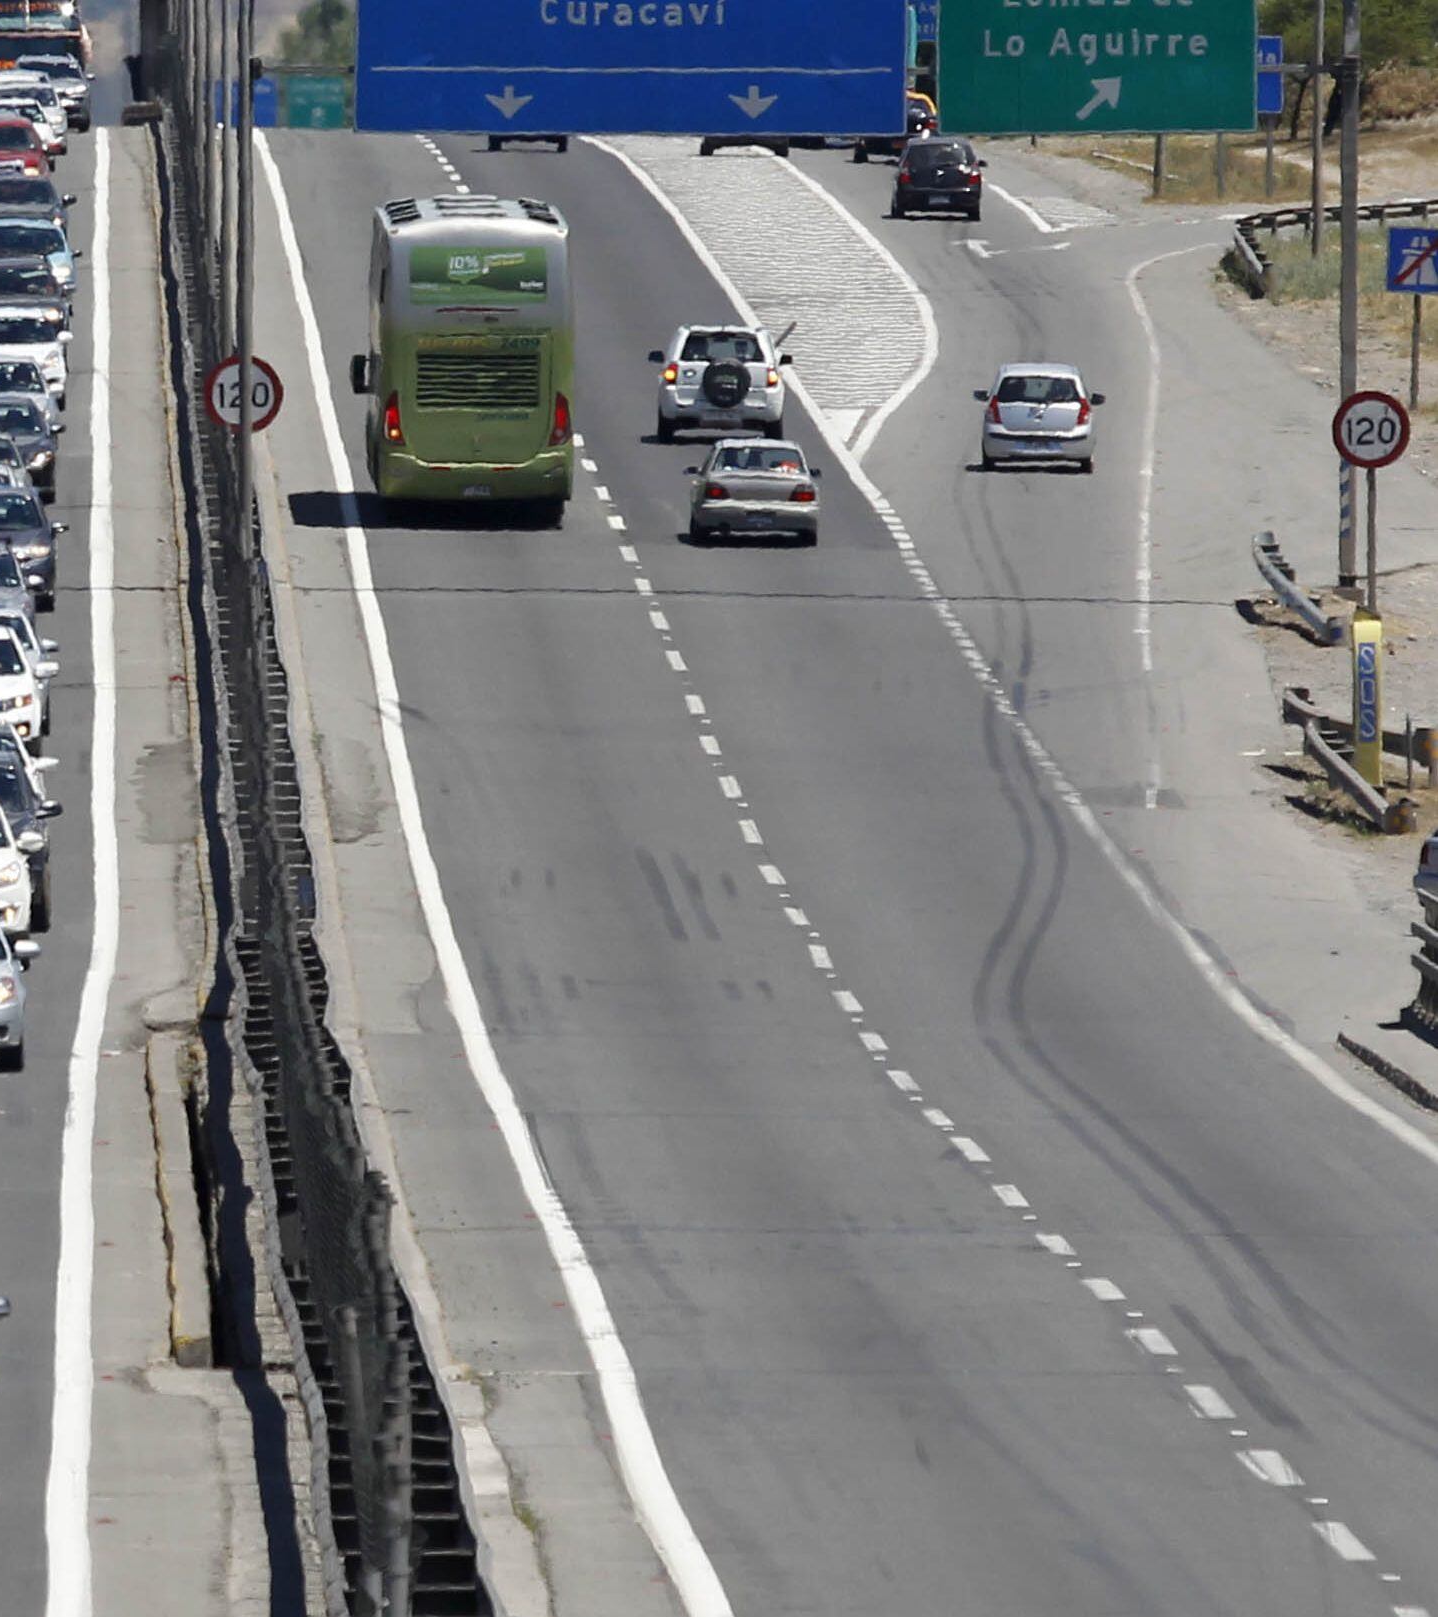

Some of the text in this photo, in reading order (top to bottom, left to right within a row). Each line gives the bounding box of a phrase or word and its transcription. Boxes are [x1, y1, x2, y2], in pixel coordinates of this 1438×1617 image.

[984, 27, 1209, 66] Lo Aguirre
[218, 382, 270, 408] 120
[1346, 417, 1397, 446] 120
[1360, 645, 1376, 738] SOS
